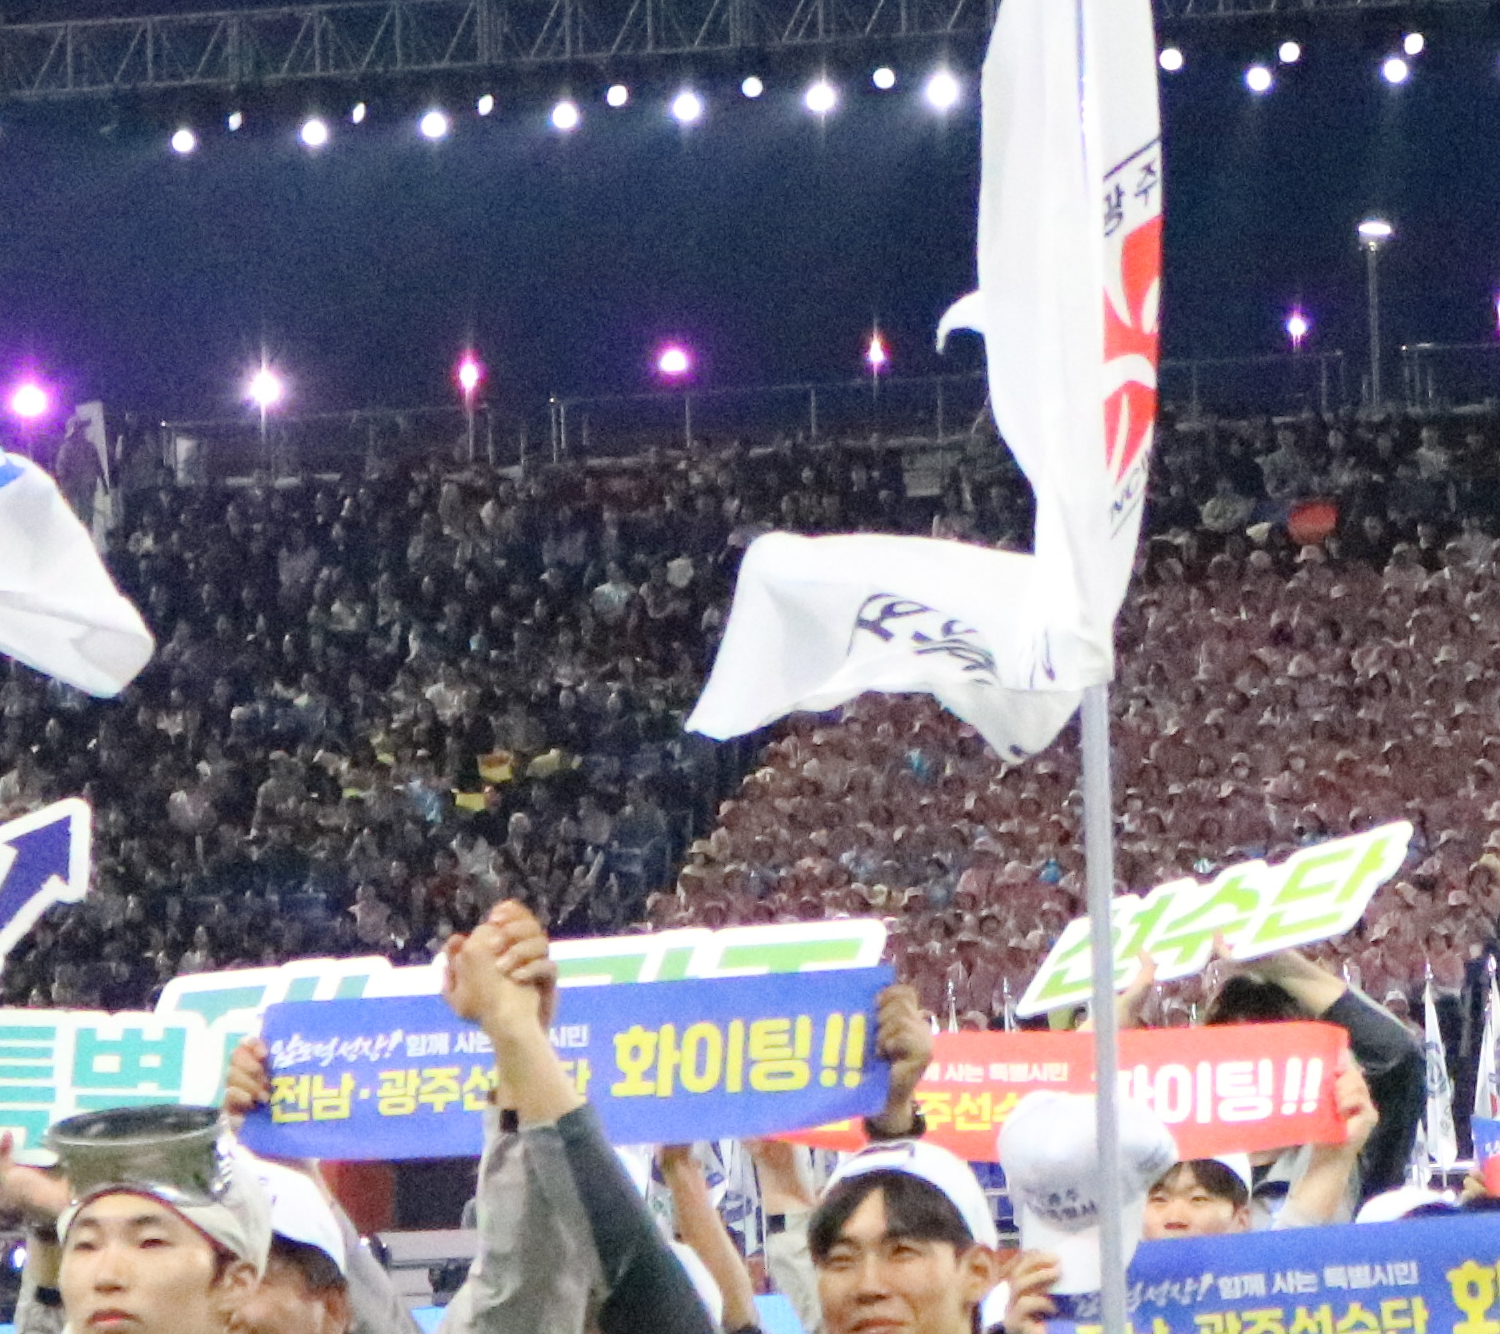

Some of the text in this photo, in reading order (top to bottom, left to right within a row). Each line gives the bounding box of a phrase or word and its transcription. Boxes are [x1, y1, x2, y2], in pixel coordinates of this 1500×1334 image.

[406, 1031, 450, 1058] 함께
[610, 1013, 867, 1099] 화이팅!!
[1217, 1272, 1268, 1301] 함께
[1271, 1269, 1320, 1295] 사는
[1322, 1260, 1419, 1290] 특별시민
